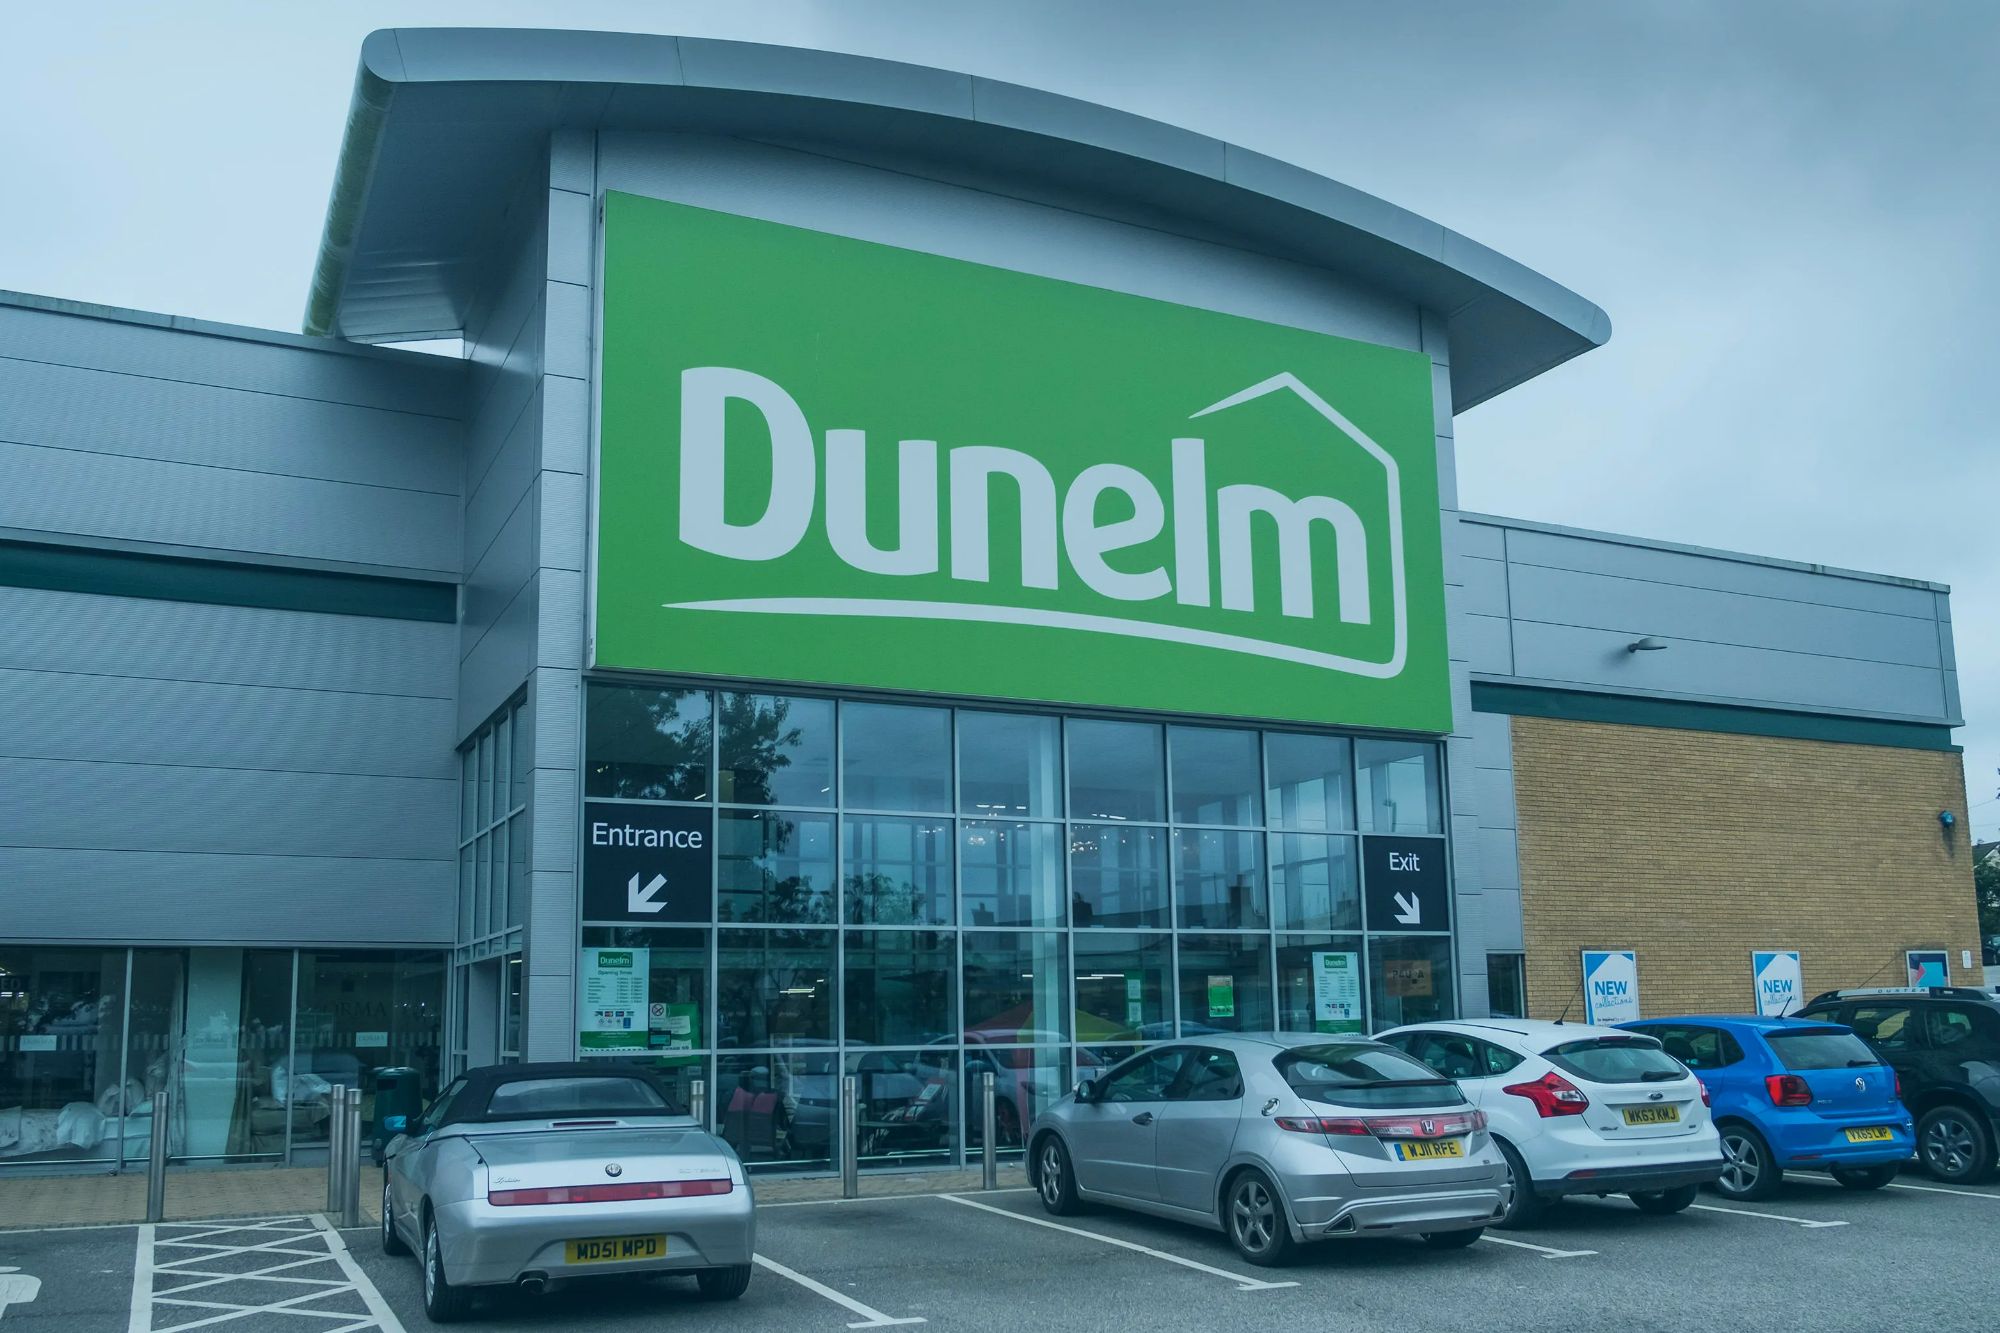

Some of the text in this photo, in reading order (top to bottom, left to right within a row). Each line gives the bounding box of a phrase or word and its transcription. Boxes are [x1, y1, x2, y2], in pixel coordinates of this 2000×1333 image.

[679, 366, 1371, 625] Dunelm
[592, 822, 703, 849] Entrance
[1389, 852, 1420, 871] Exit
[1594, 980, 1628, 995] NEW
[1763, 979, 1793, 993] NEW
[1627, 1108, 1656, 1123] WK63
[1848, 1127, 1873, 1140] VX65
[1407, 1141, 1457, 1158] WJ11 RFE
[577, 1238, 657, 1260] MD51 MPD
